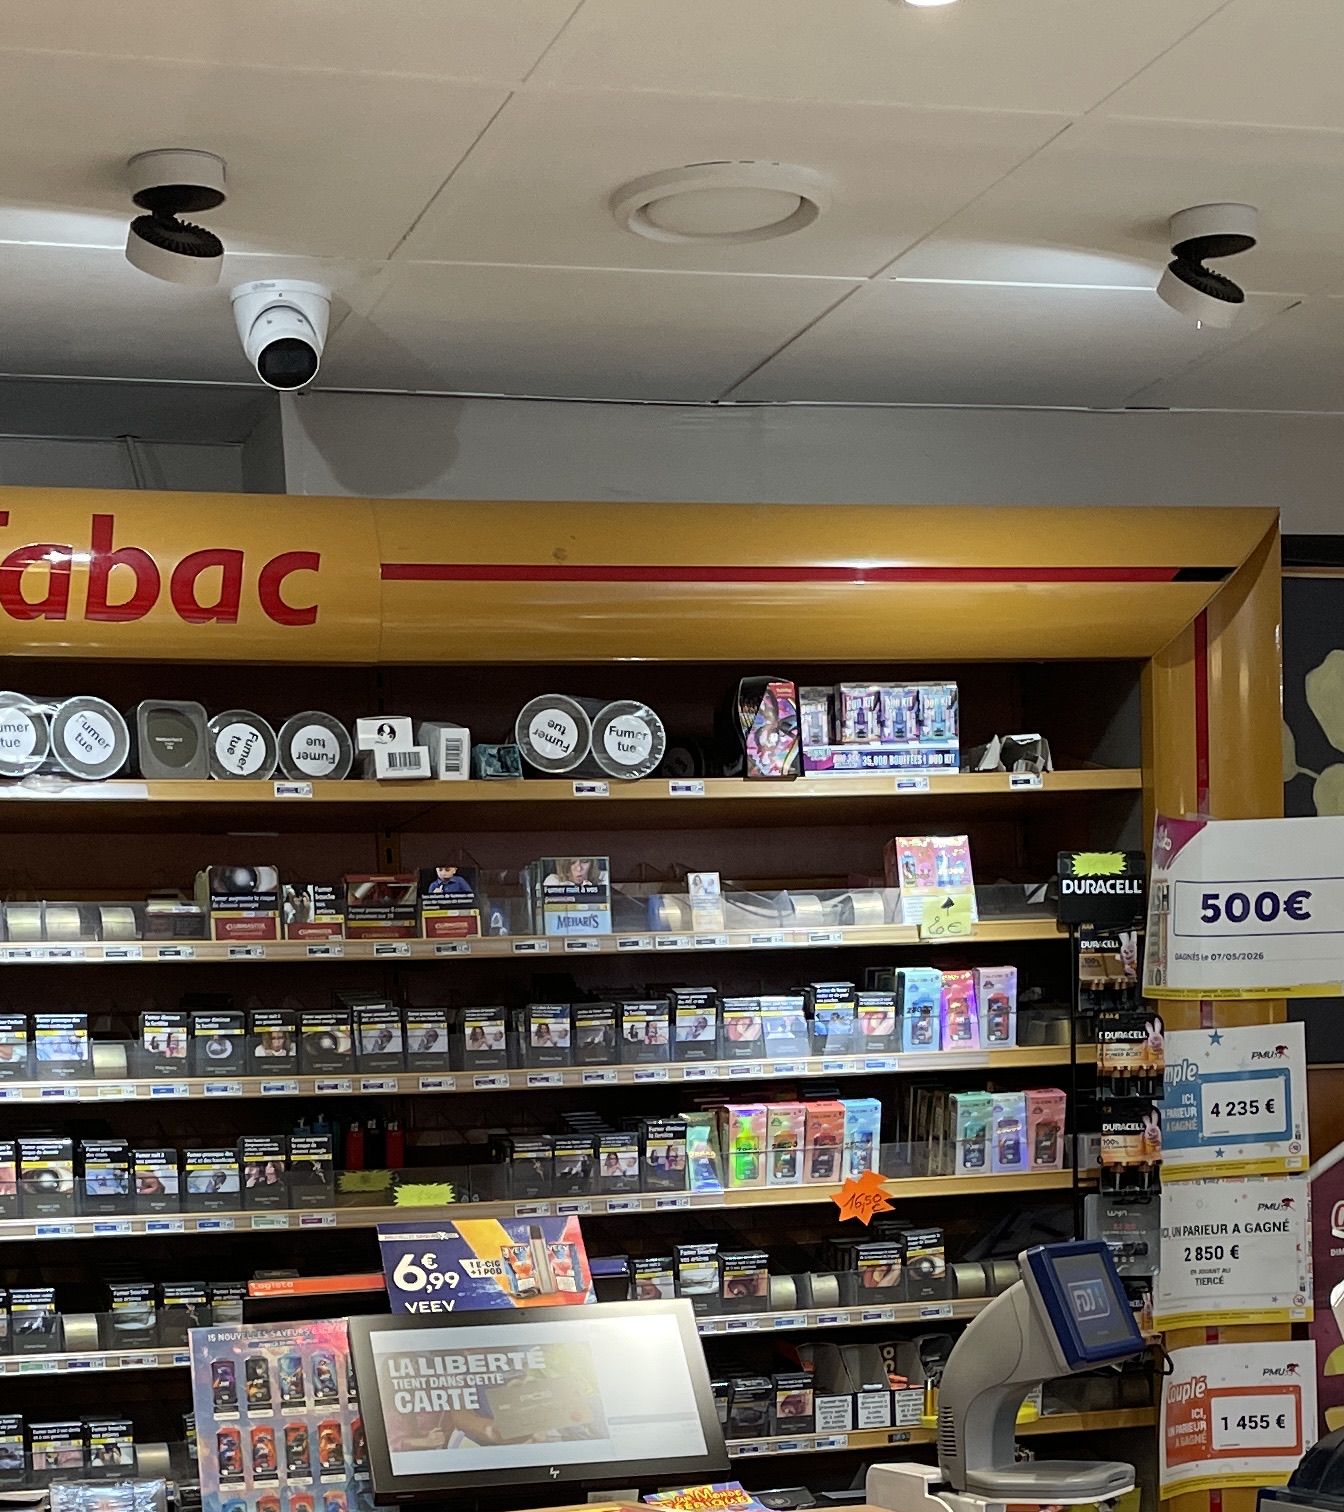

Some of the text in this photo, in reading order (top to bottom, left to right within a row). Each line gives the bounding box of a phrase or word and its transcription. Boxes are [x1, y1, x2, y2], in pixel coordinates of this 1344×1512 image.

[1199, 890, 1313, 924] 500€
[1251, 1050, 1277, 1061] PMU
[1210, 1098, 1276, 1118] 4 235 €
[1182, 1217, 1290, 1238] PARIEUR A GAGNÉ
[1184, 1244, 1240, 1263] 2 850 €
[388, 1343, 547, 1378] LA LIBERTÉ
[392, 1373, 505, 1390] TIENT DANS CETTE
[1166, 1375, 1207, 1405] Couplé
[395, 1385, 481, 1414] CARTE
